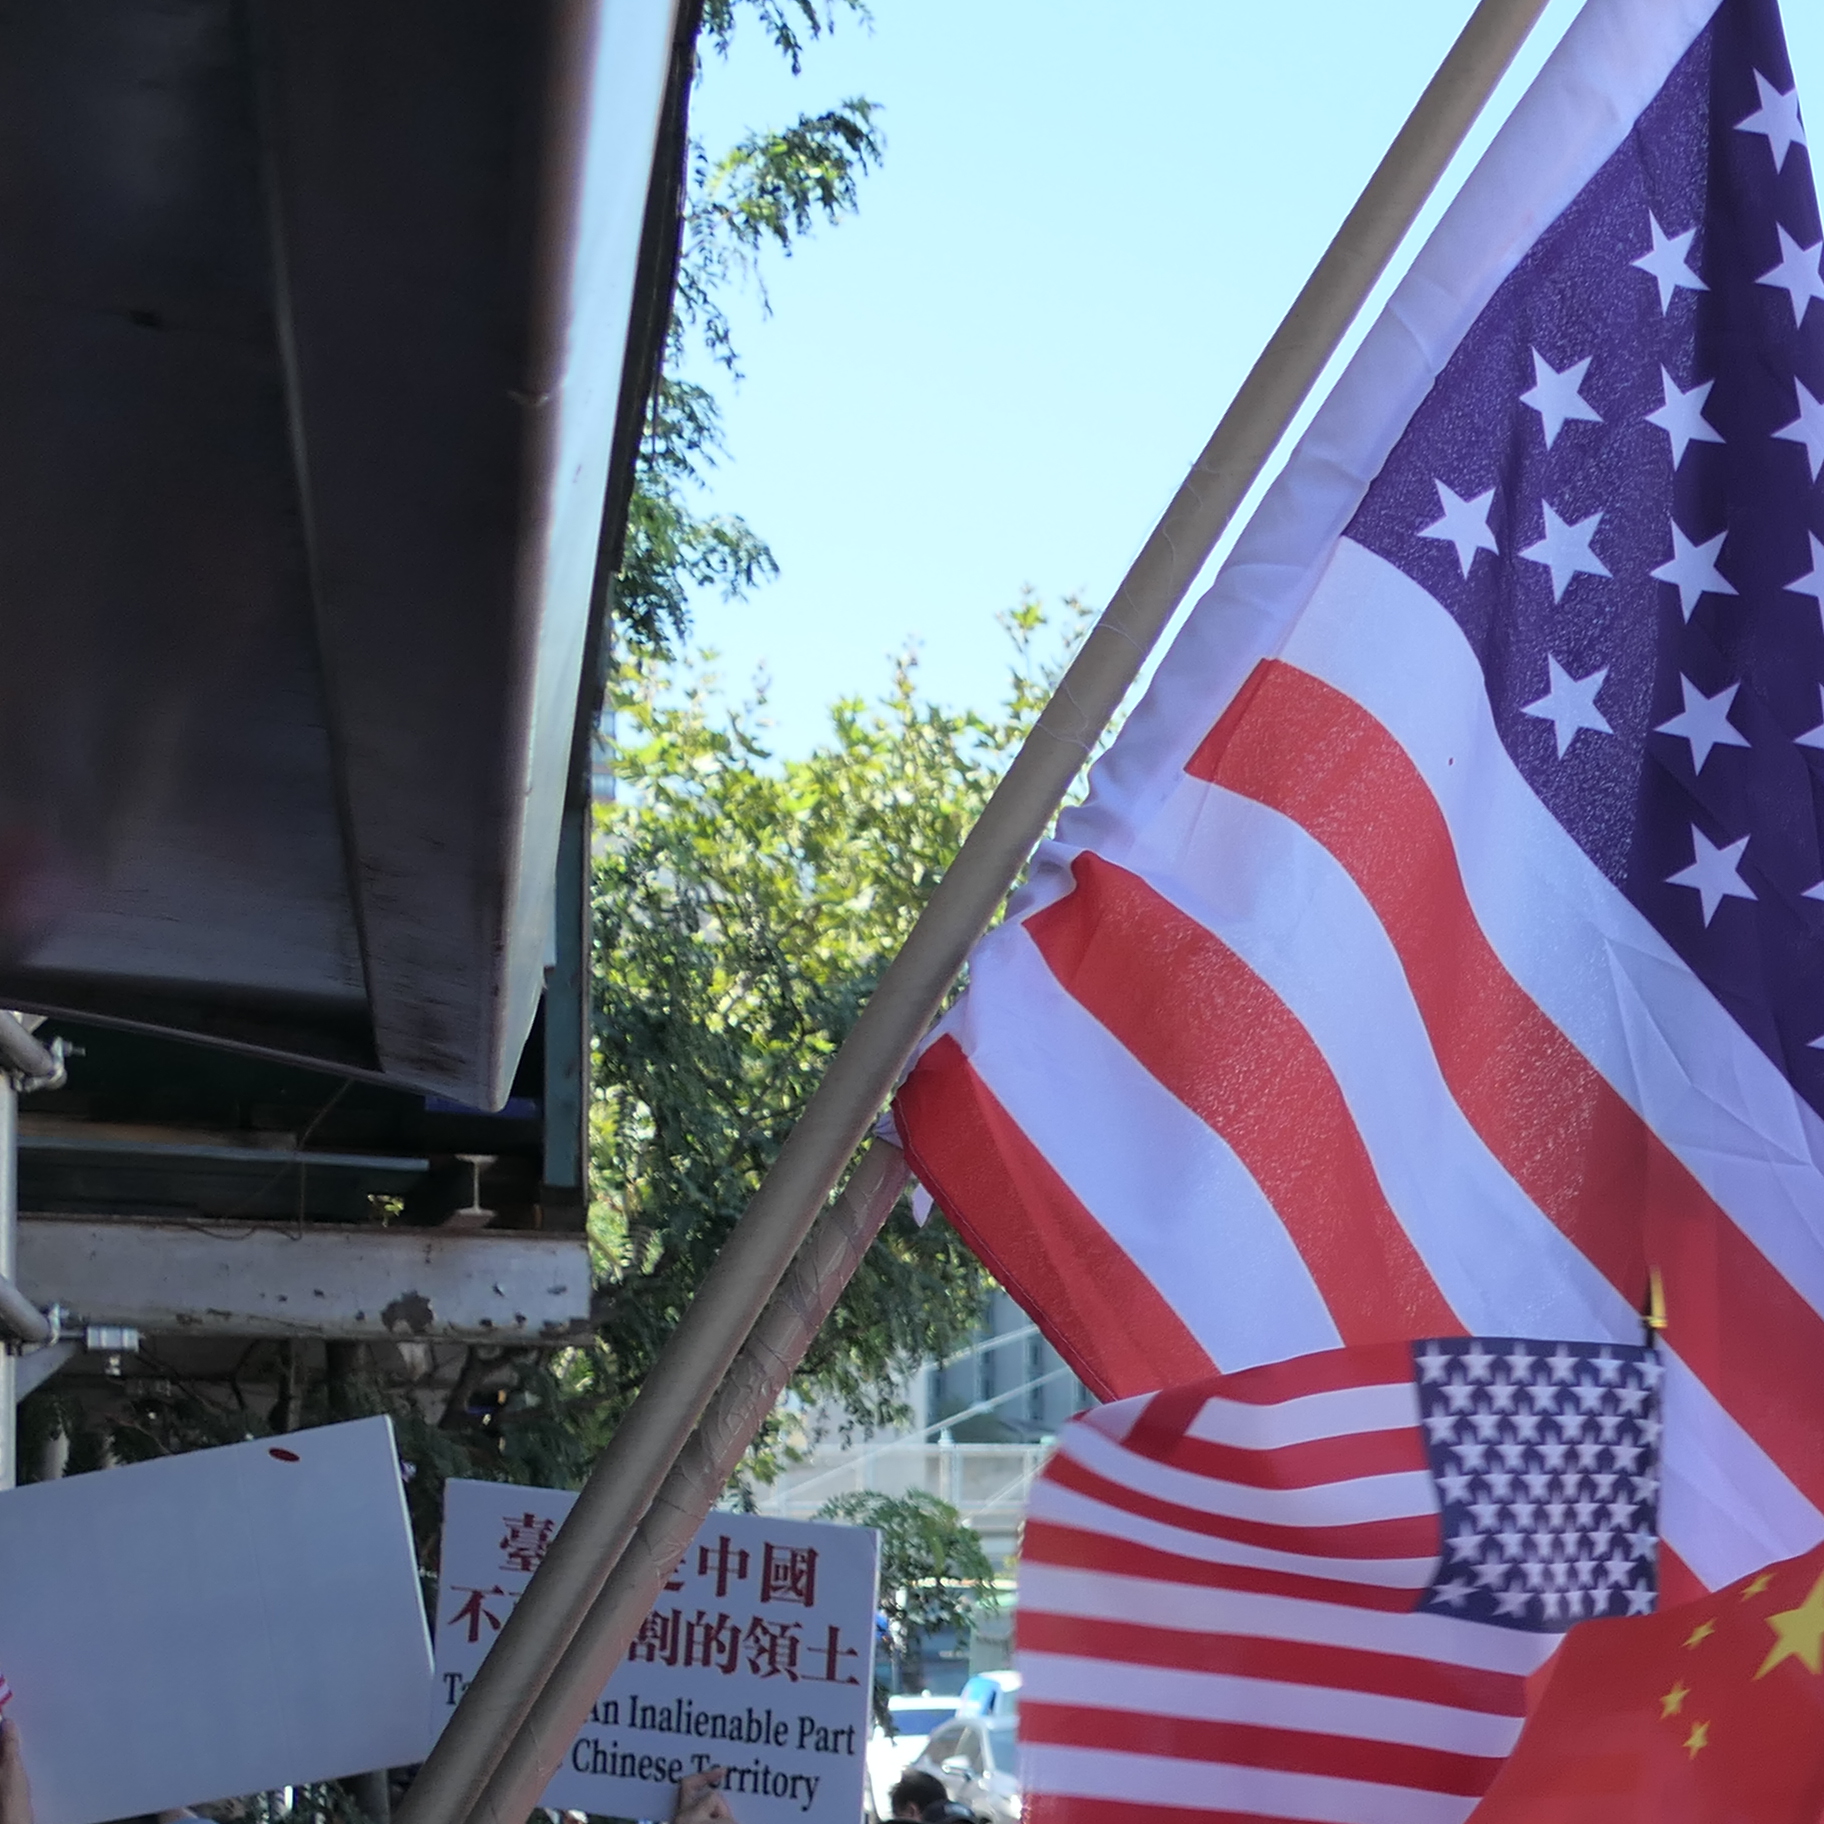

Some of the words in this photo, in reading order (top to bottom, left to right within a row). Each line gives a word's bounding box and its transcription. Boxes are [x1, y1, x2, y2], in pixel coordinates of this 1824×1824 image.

[499, 1511, 819, 1608] 臺中國
[448, 1583, 861, 1687] 不割的領土
[571, 1737, 684, 1784] Chinese
[628, 1694, 789, 1748] Inalienable
[797, 1715, 856, 1756] Part
